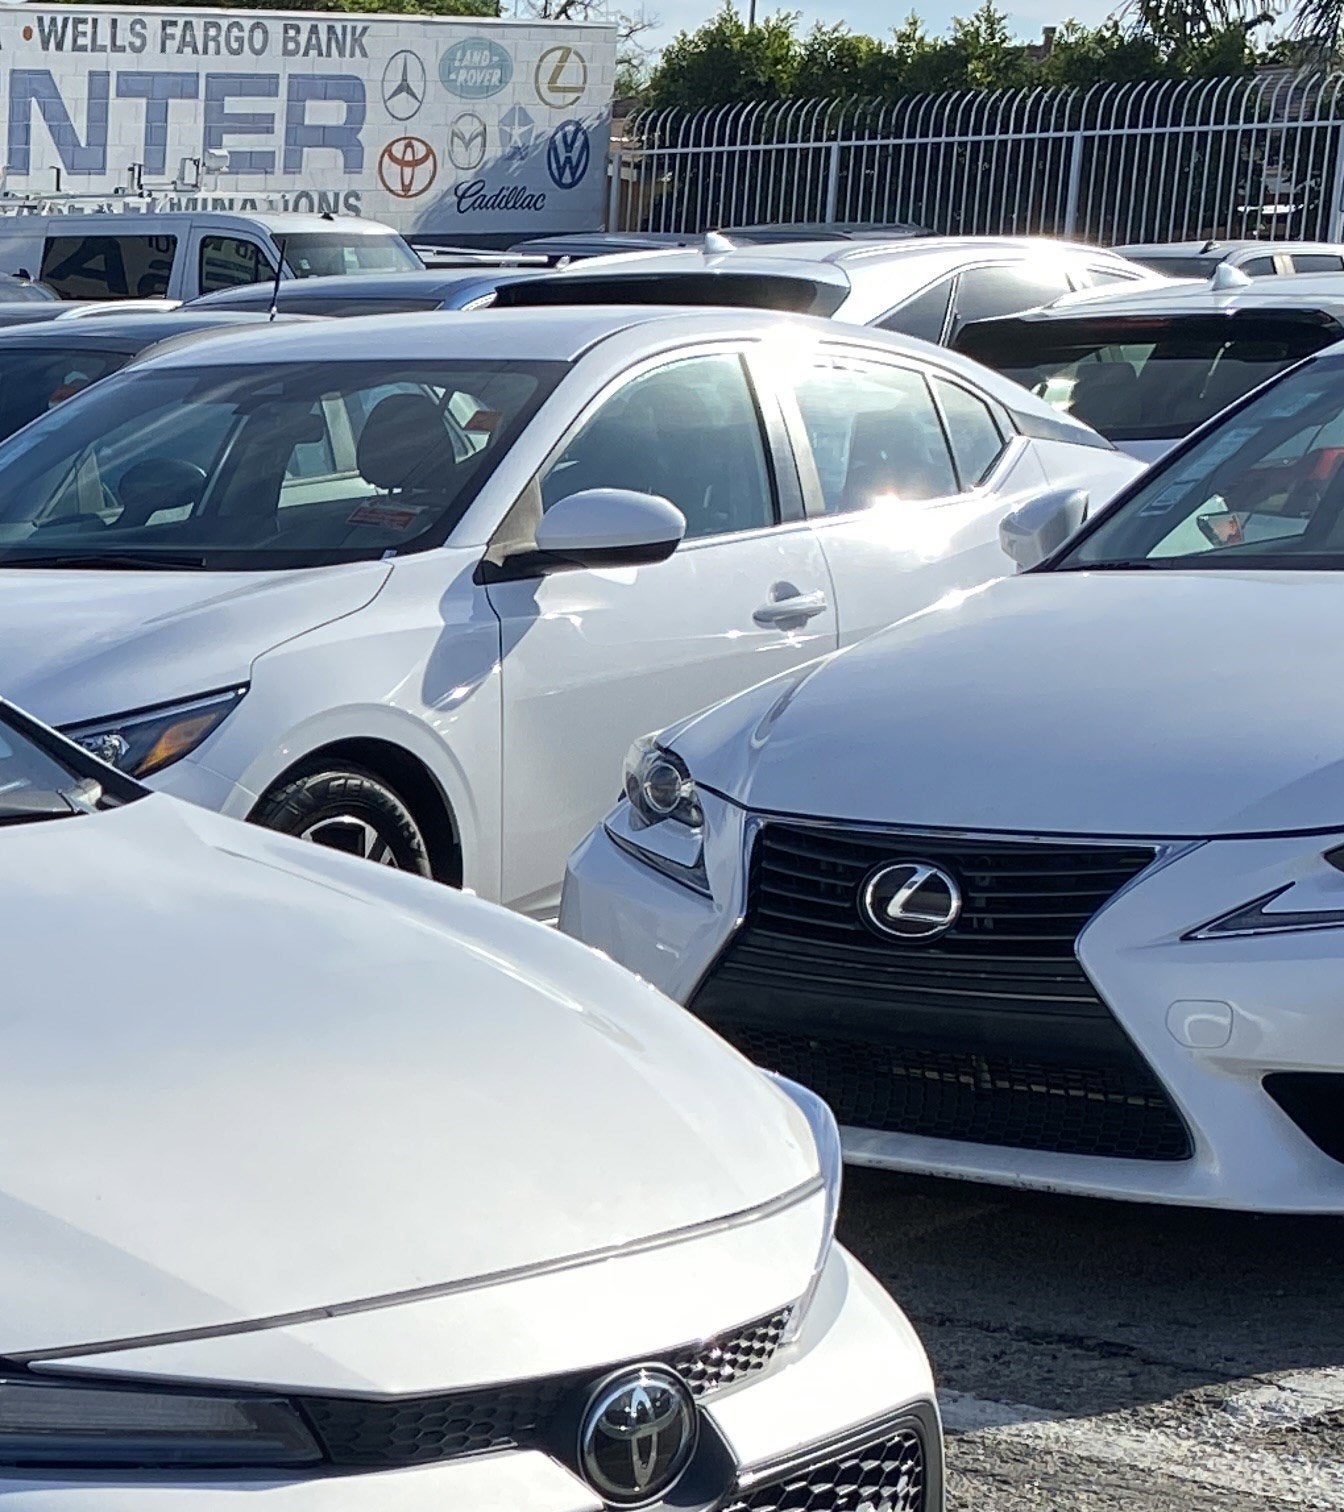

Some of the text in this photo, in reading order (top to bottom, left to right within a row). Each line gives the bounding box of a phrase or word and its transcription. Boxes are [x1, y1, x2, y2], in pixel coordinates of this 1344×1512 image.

[37, 15, 370, 58] WELLS FARGO BANK
[454, 179, 546, 213] Cadillac
